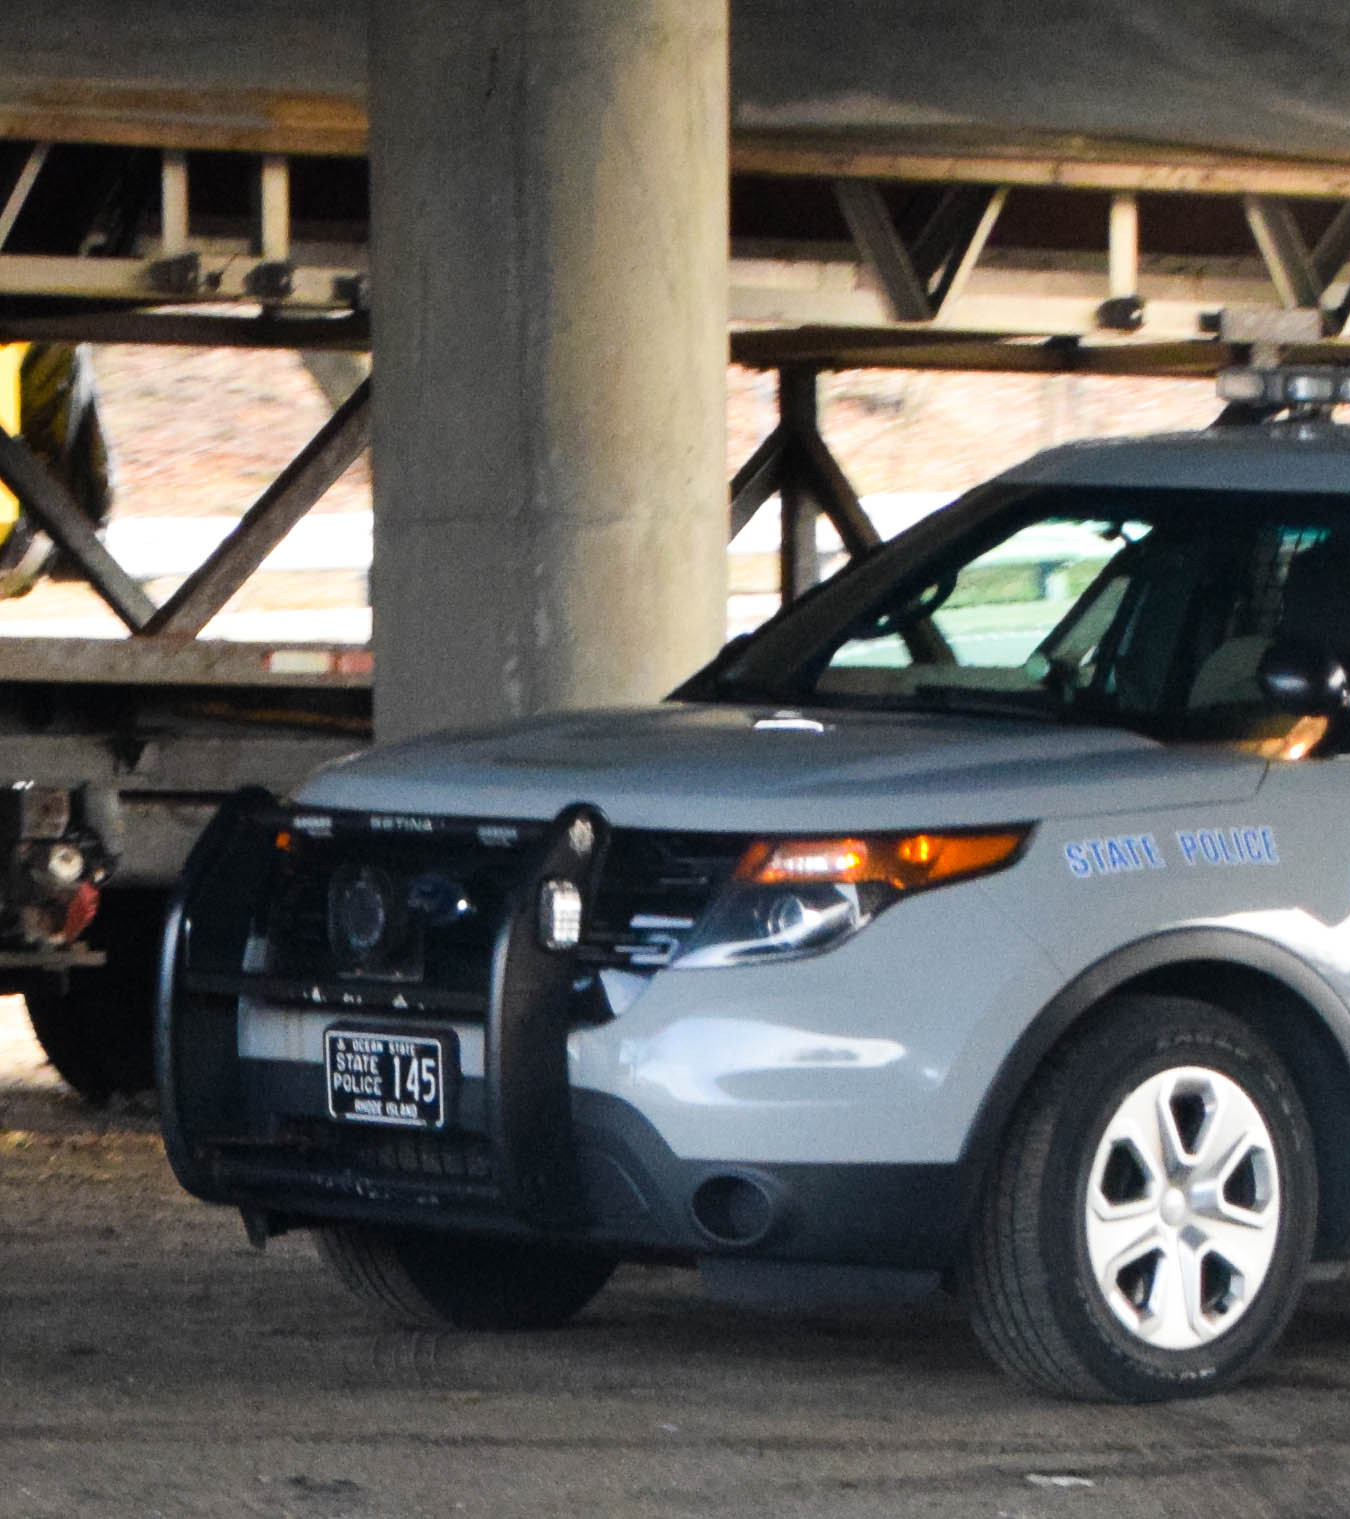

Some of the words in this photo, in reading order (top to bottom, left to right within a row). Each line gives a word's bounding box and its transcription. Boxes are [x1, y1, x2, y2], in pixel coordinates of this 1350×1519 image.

[1064, 833, 1167, 878] STATE
[1176, 824, 1280, 866] POLICE
[336, 1053, 379, 1075] STATE
[333, 1072, 382, 1096] POLICE
[393, 1055, 436, 1103] 145
[385, 1101, 418, 1118] ISLAND
